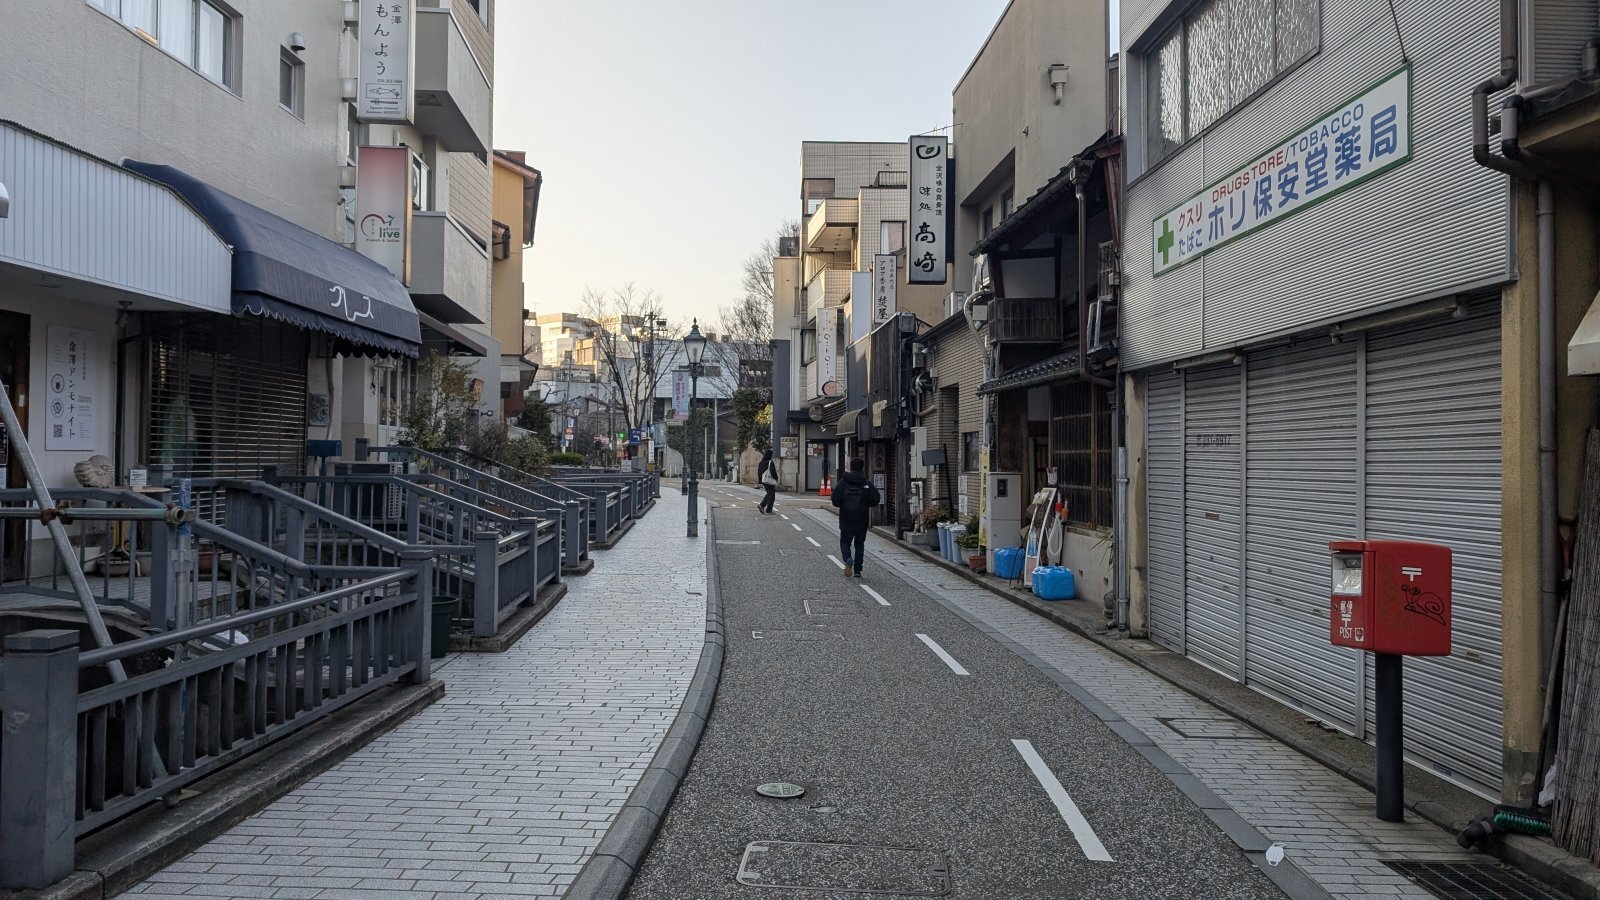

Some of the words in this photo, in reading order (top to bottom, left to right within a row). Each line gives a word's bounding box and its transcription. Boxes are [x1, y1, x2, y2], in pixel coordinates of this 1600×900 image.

[391, 5, 402, 24] 金澤
[374, 4, 389, 75] もんよう
[1213, 104, 1363, 203] DRUGSTORE/TOBACCO
[1208, 104, 1398, 242] ホリ保安堂薬局
[1178, 201, 1203, 232] クスリ
[1178, 228, 1203, 258] たばこ
[68, 340, 77, 439] 金澤アンモナイト
[1340, 600, 1353, 615] 郵便
[1340, 626, 1353, 639] POST
